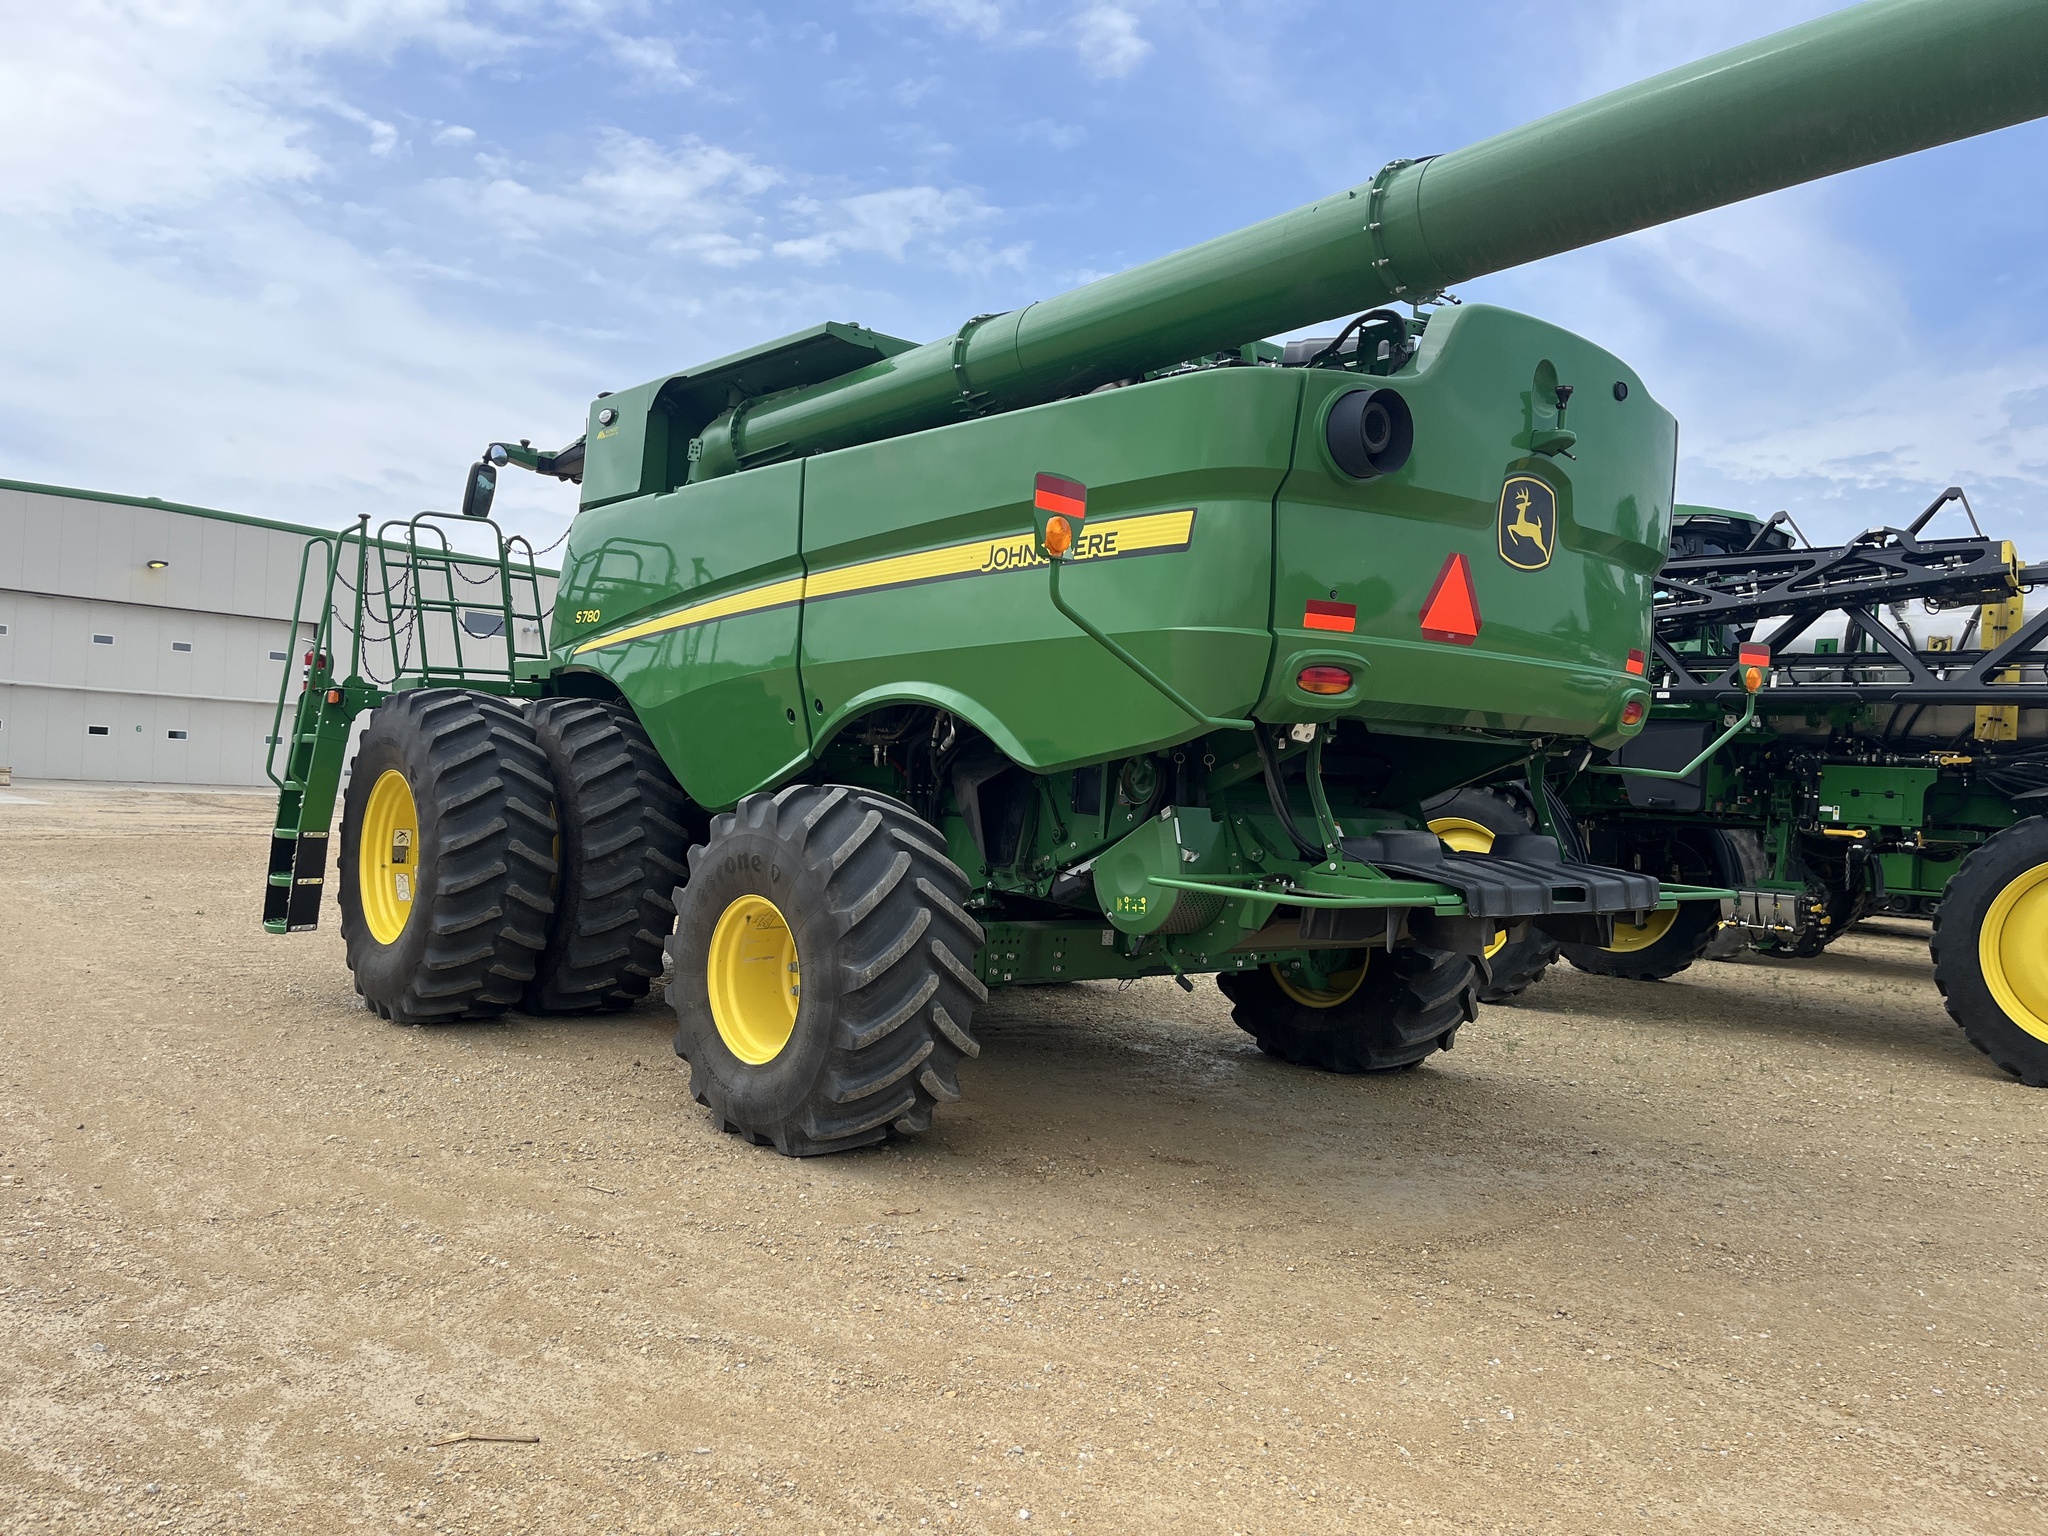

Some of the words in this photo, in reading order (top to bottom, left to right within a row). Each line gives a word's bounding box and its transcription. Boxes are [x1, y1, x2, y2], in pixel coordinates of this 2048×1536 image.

[981, 544, 1038, 569] JOHN
[1073, 531, 1119, 557] ERE
[575, 608, 601, 623] S780
[135, 725, 142, 733] 6
